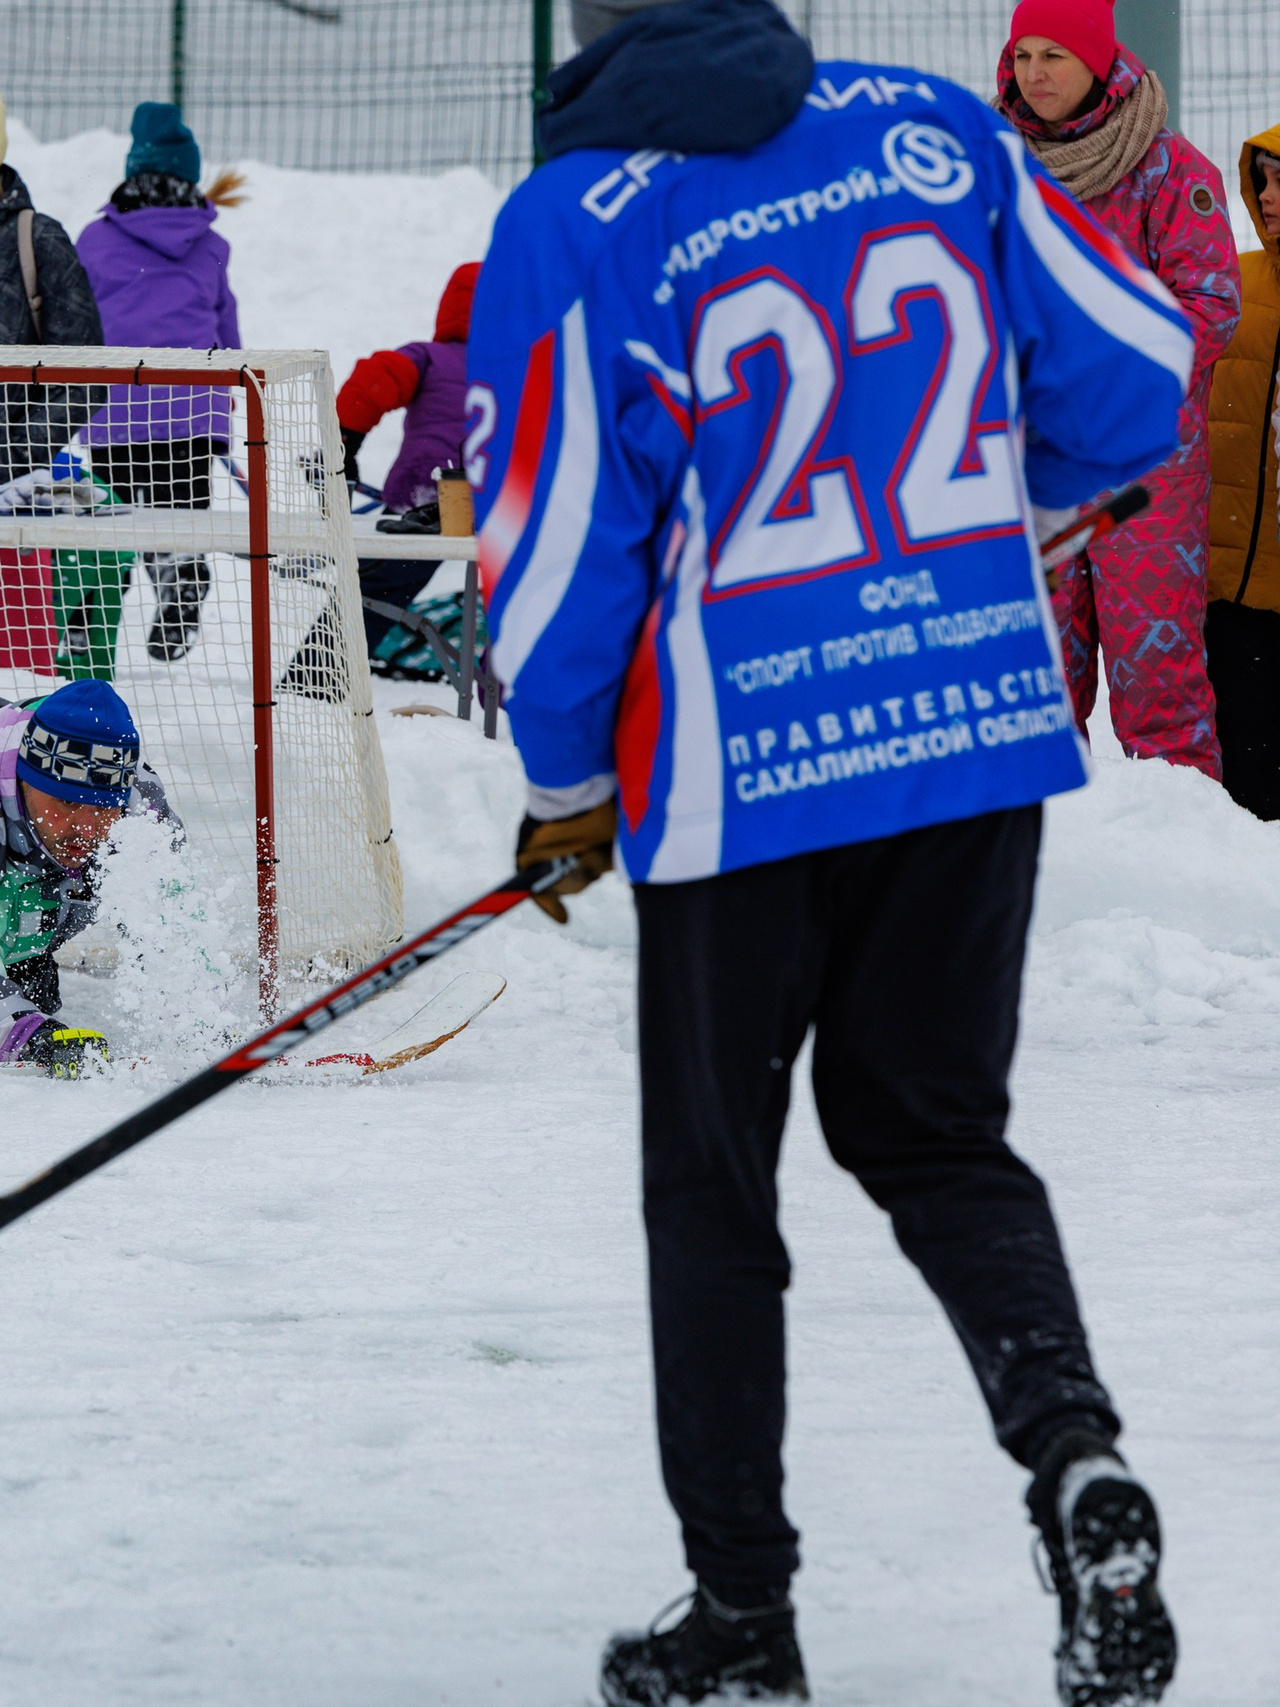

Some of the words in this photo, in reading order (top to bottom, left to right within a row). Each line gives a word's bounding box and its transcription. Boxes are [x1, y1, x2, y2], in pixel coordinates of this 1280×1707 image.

[689, 221, 1025, 604] 22
[859, 569, 940, 613] ФОНД
[821, 622, 919, 672] ПРОТИВ
[735, 718, 974, 802] САХАЛИНСКОЙ
